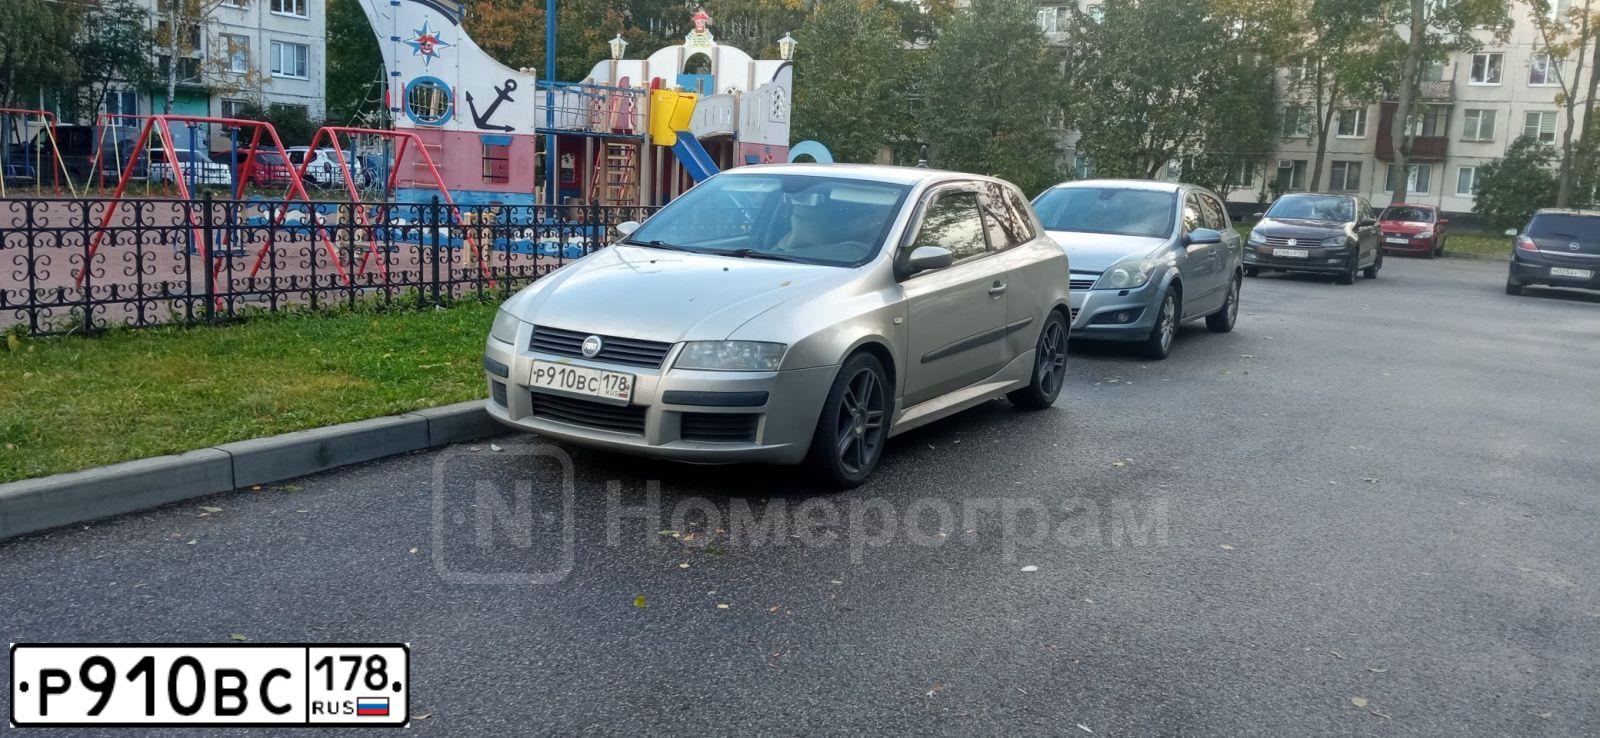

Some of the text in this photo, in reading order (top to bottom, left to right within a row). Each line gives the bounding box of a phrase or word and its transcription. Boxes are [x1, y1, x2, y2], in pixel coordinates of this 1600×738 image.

[584, 342, 598, 350] FIAT
[536, 366, 627, 392] Р910ВС 178
